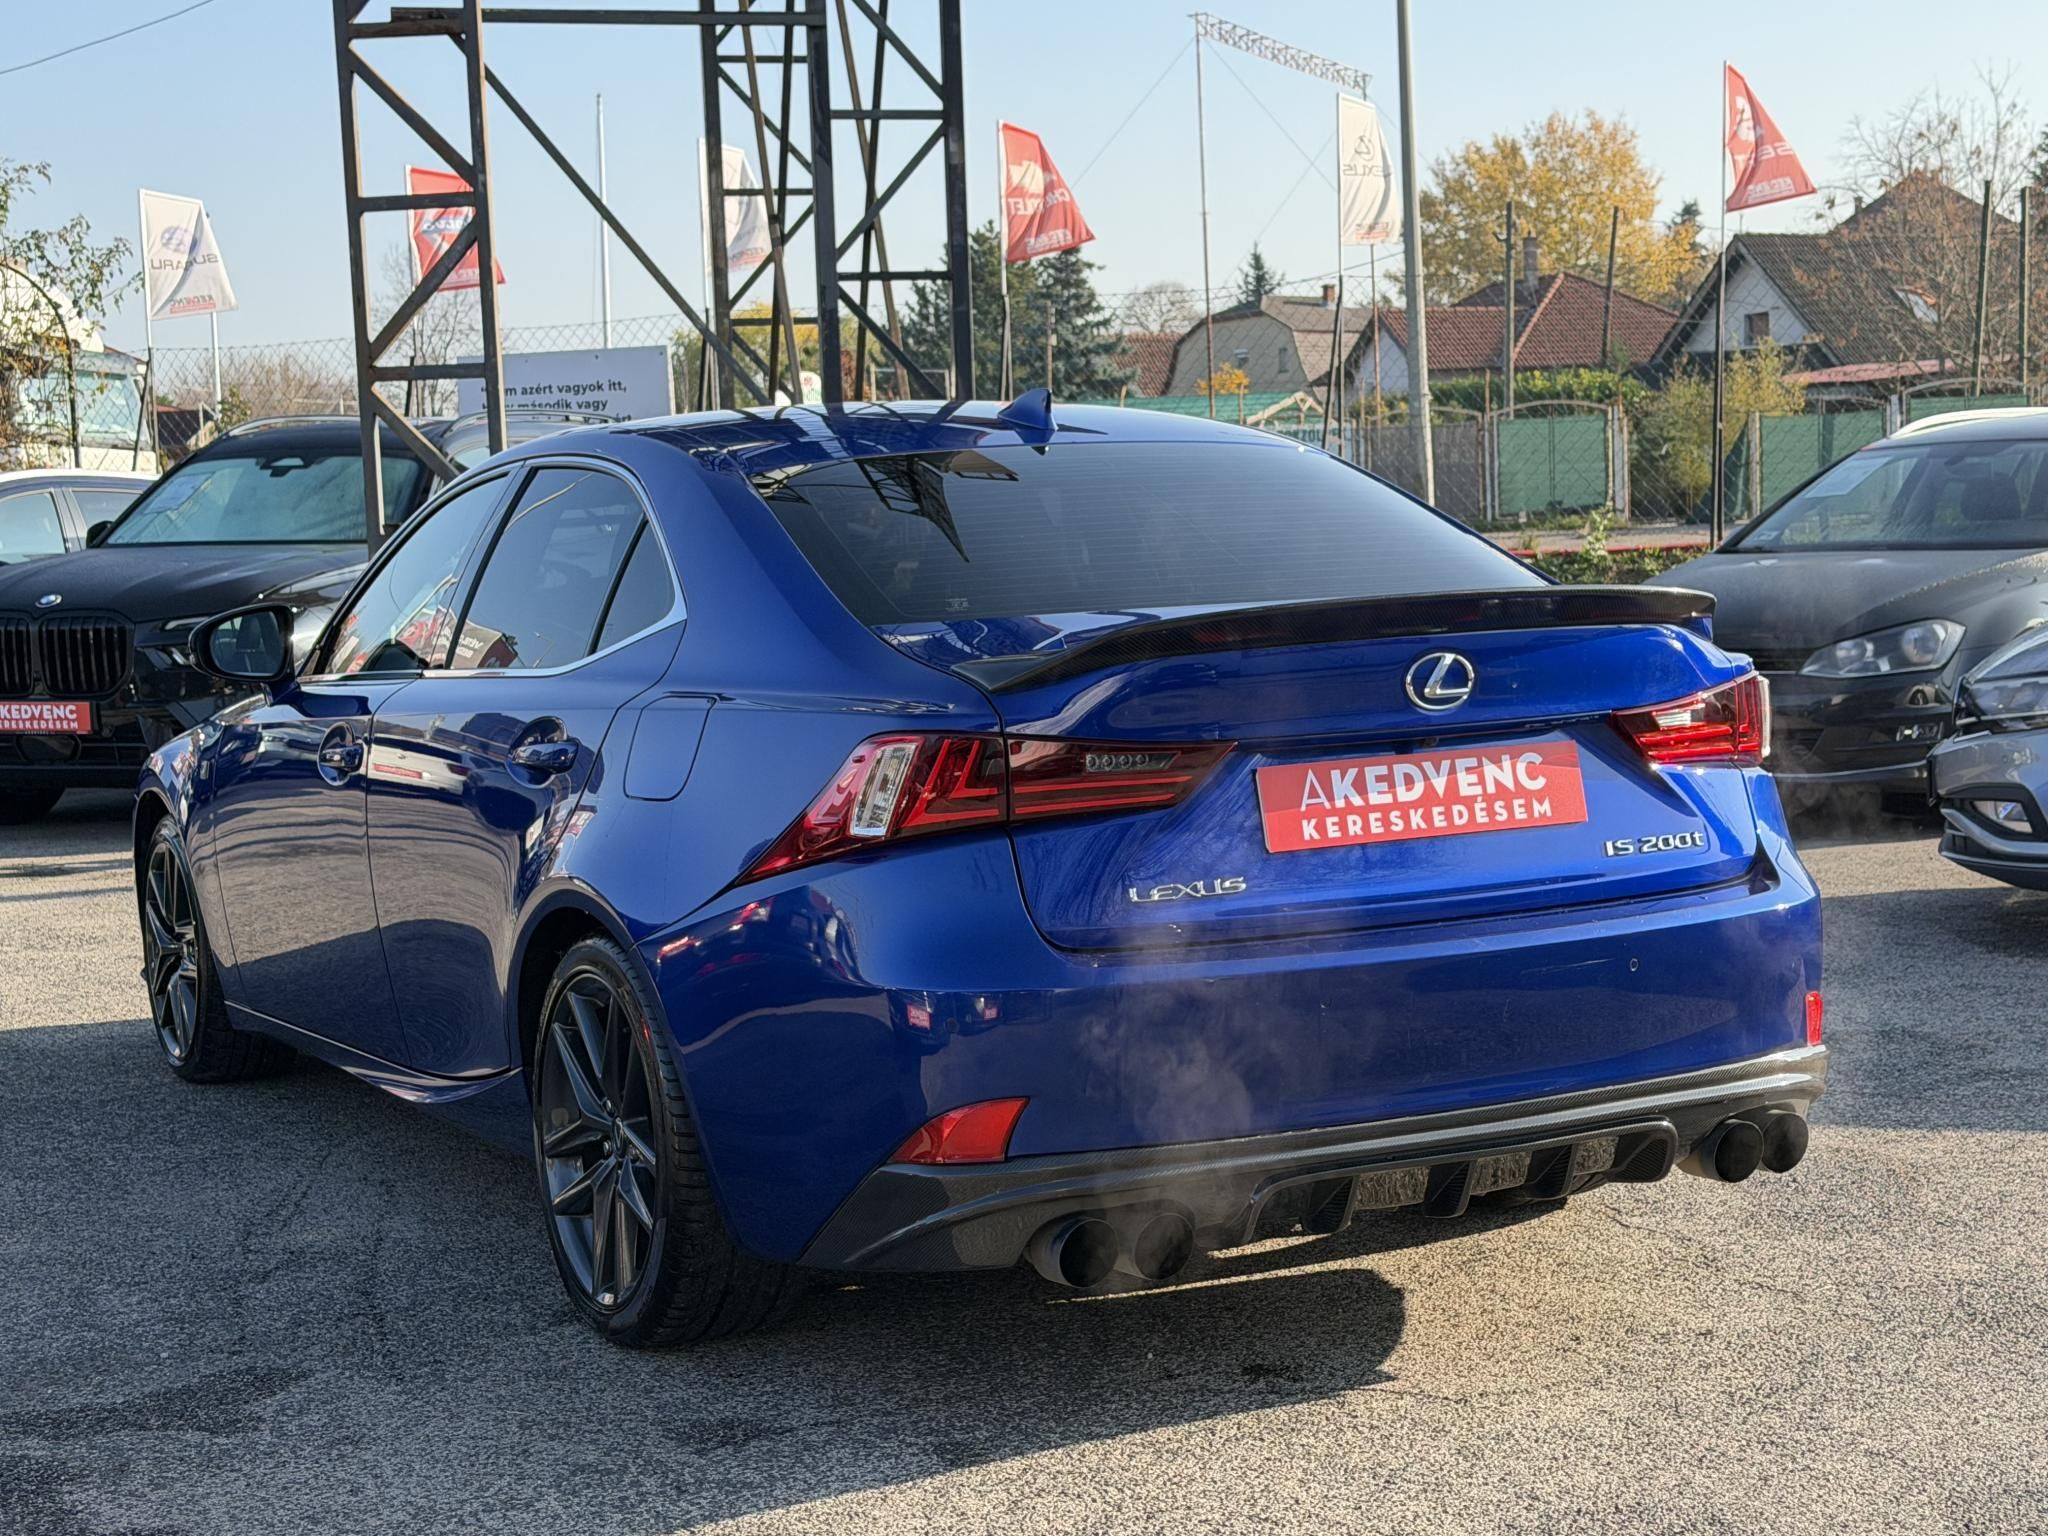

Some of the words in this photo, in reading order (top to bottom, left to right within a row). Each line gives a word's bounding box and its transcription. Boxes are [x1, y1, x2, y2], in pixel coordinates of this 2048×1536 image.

[521, 382, 553, 396] azért
[557, 379, 604, 395] vagyok
[608, 379, 627, 392] itt,
[577, 399, 608, 411] vagy
[1301, 796, 1552, 841] KERESKEDÉSEM
[1605, 839, 1634, 856] IS
[1639, 831, 1705, 853] 200t
[1129, 876, 1247, 902] LEXUS
